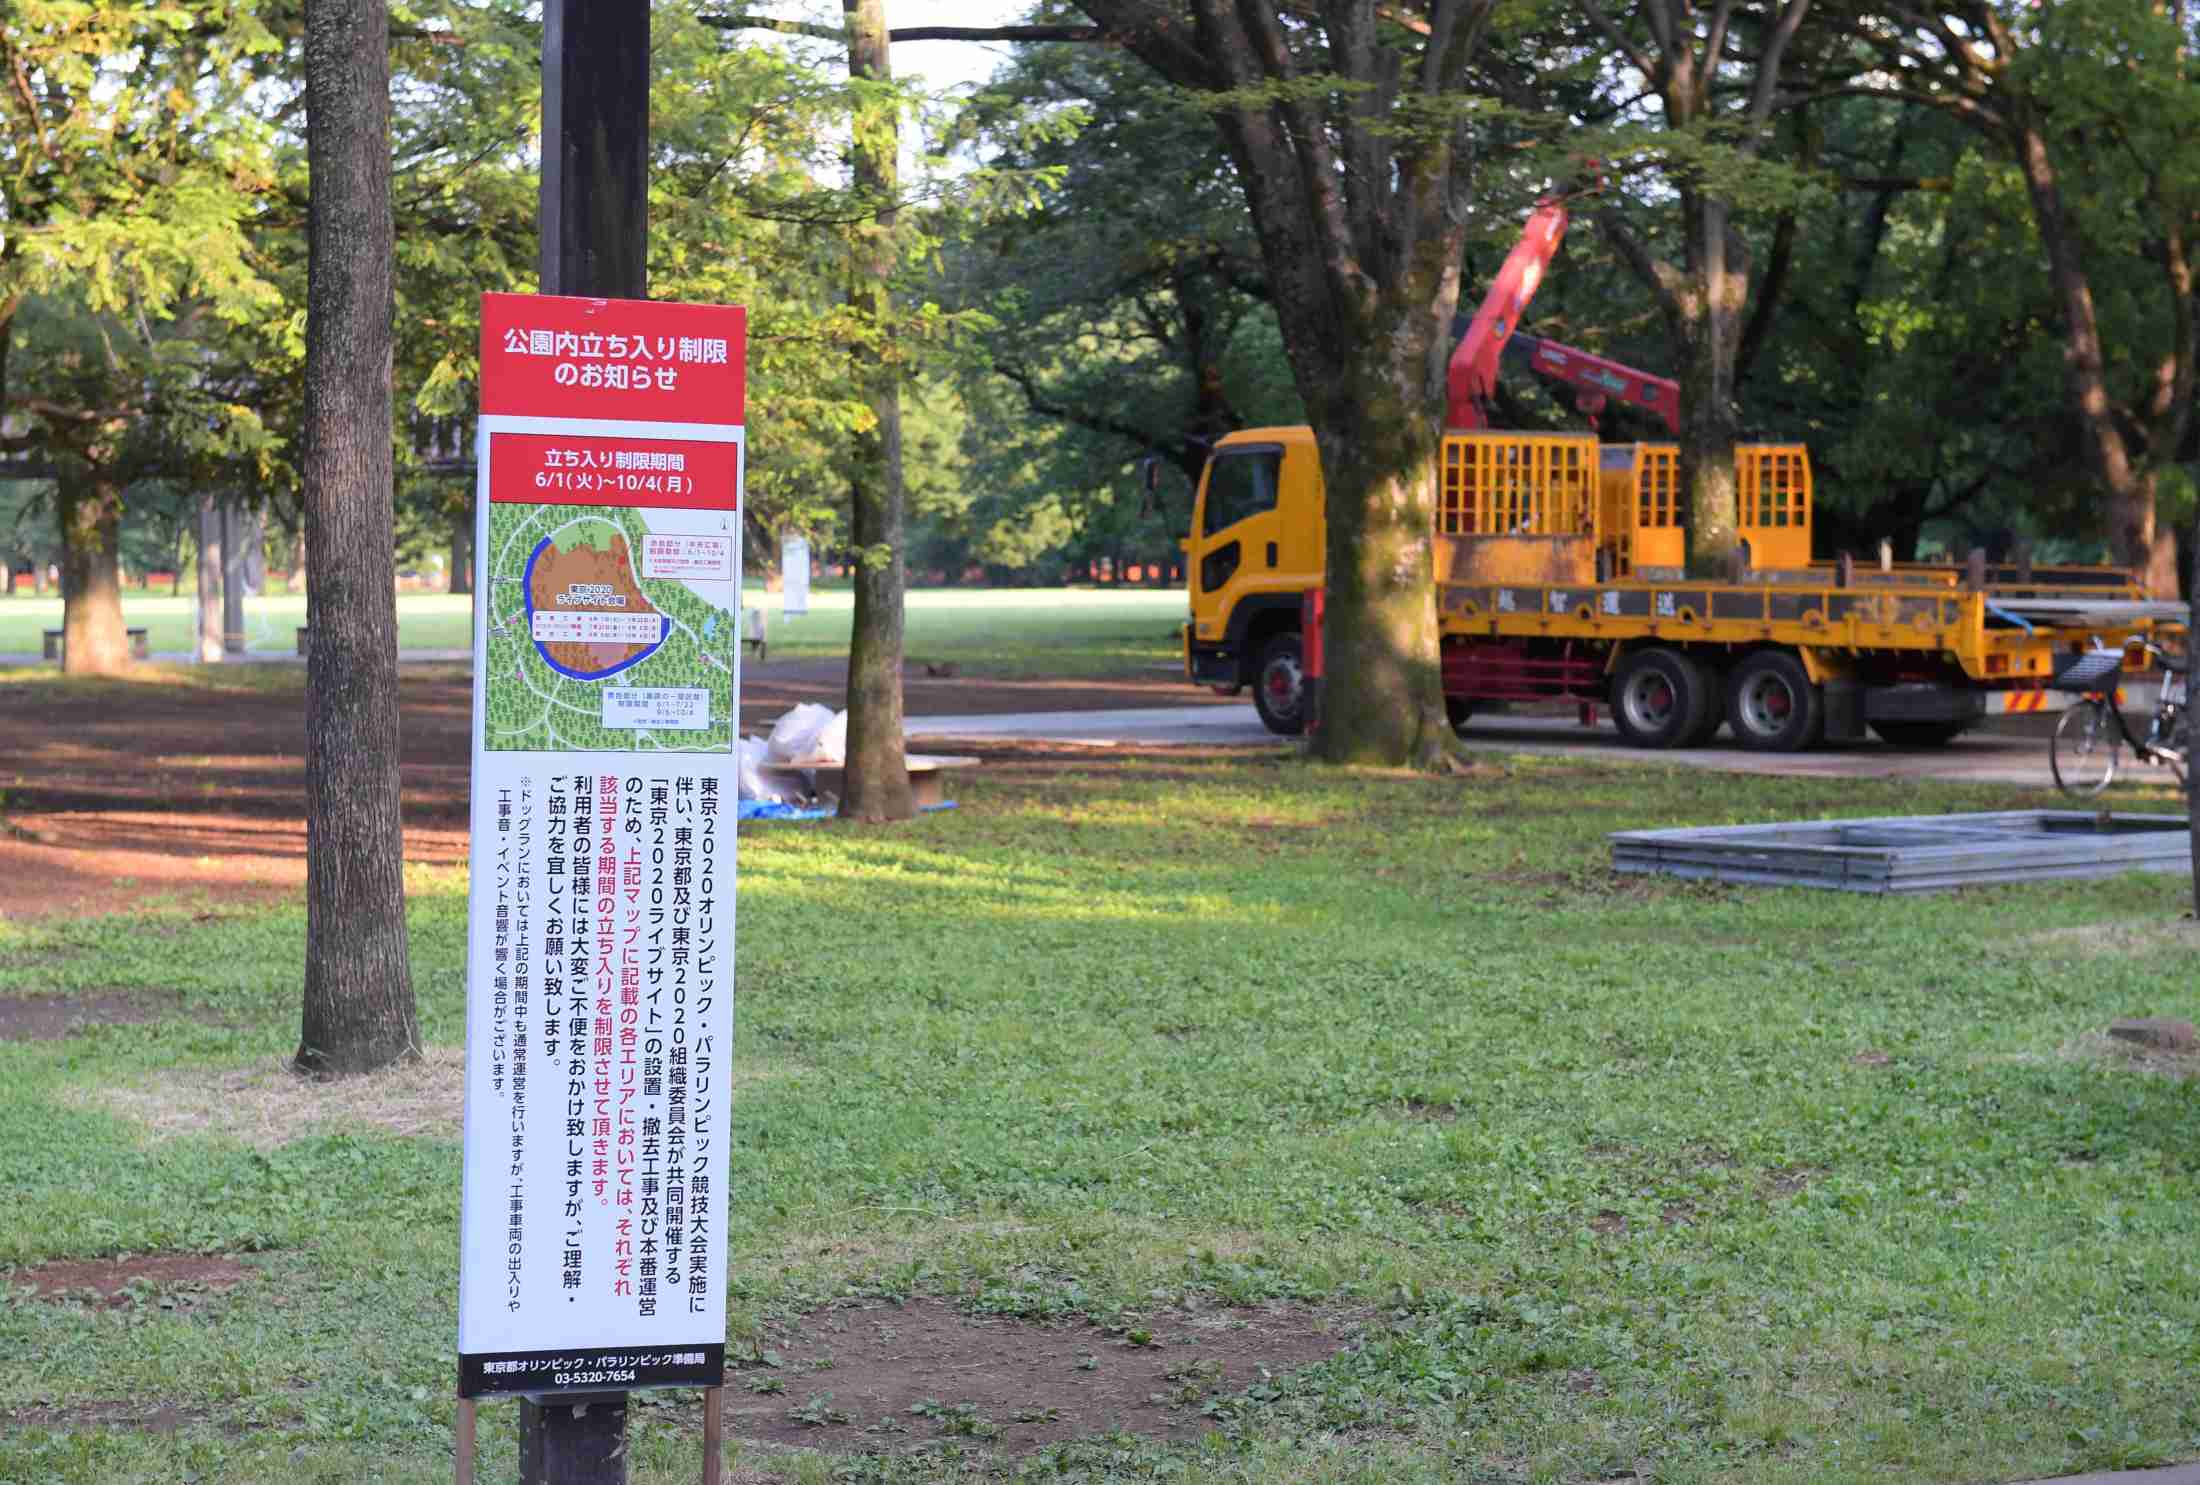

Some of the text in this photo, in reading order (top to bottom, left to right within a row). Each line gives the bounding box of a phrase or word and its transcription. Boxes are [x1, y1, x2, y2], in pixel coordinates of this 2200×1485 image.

[504, 329, 728, 364] 公園内立ち入り制限
[555, 363, 678, 391] のお知らせ
[544, 449, 685, 472] 立ち入り制限期間
[544, 776, 568, 1067] ご協力を宜しくお願い致します。
[591, 776, 620, 1206] 該当する期間の立ち入りを制限させて頂きます。
[664, 776, 694, 1285] 伴い、東京都及び東京2020組織委員会が共同開催する
[688, 777, 719, 1313] 東京2020オリンピック・パラリンピック競技大会実施に
[483, 1352, 705, 1374] 東京都オリンピック・パラリンピック準備局
[554, 1370, 636, 1384] 03-5320-7654
